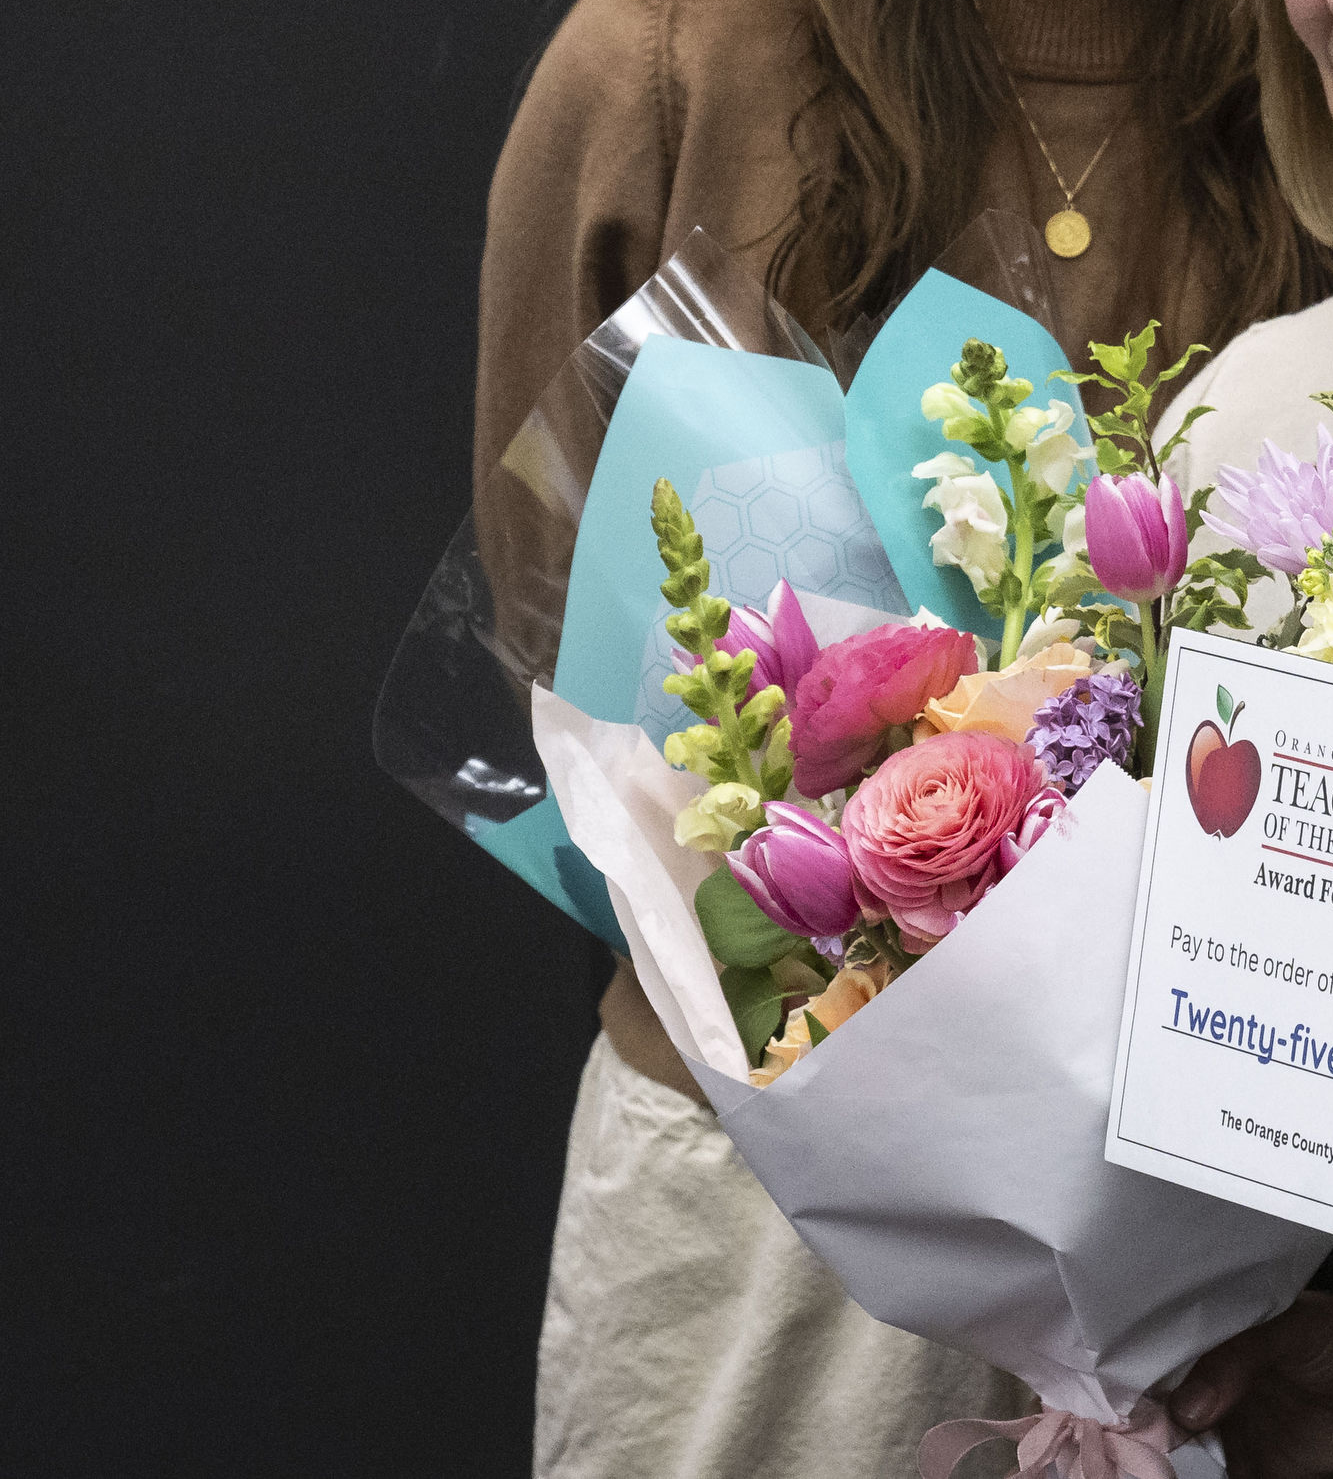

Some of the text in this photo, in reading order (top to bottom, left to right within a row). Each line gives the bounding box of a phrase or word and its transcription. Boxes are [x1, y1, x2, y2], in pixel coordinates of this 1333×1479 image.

[1263, 811, 1291, 842] OF
[1253, 861, 1317, 901] Award
[1170, 924, 1203, 962] Pay
[1206, 935, 1225, 963] to
[1229, 942, 1259, 974] the
[1263, 957, 1314, 989] order
[1220, 1109, 1242, 1132] The
[1244, 1117, 1290, 1148] Orange
